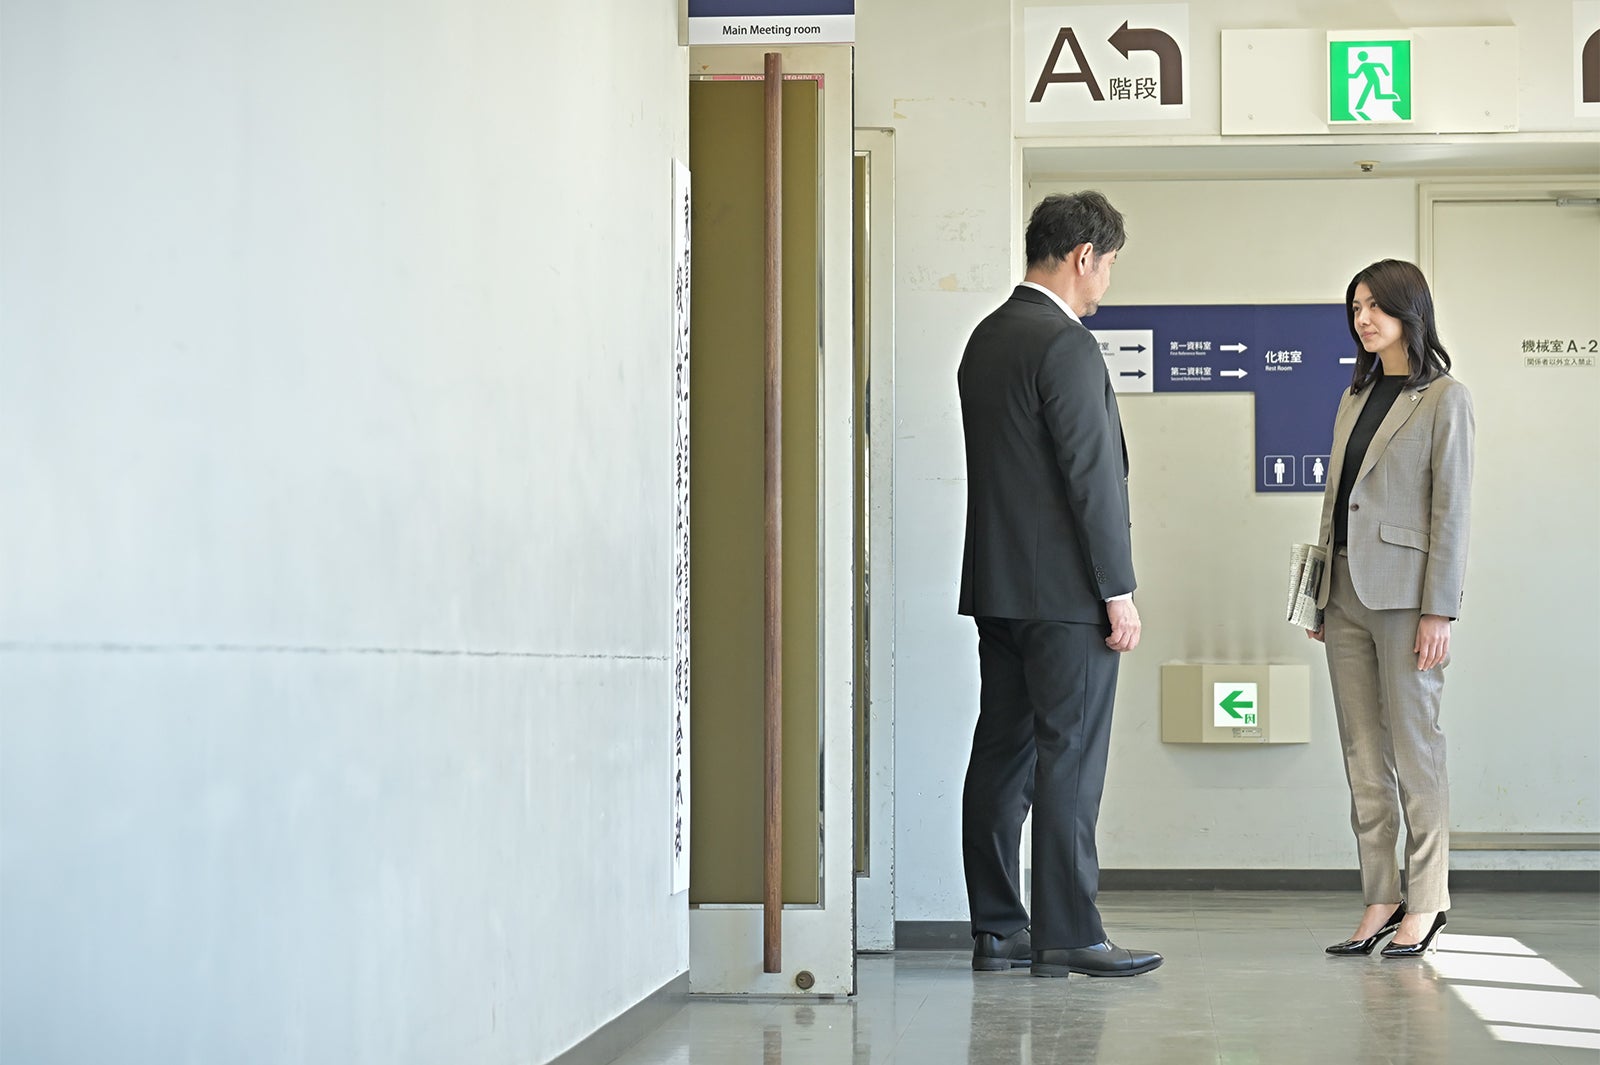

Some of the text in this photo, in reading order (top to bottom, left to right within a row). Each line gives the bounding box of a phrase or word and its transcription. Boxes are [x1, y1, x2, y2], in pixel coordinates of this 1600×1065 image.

[722, 24, 821, 37] Main Meeting room
[1029, 27, 1158, 103] A 階段
[1170, 341, 1212, 351] 第一資料室
[1521, 339, 1564, 353] 機械室
[1264, 350, 1303, 364] 化粧室
[1526, 358, 1593, 366] 関係者以外立入禁止
[1171, 366, 1212, 376] 第二資料室
